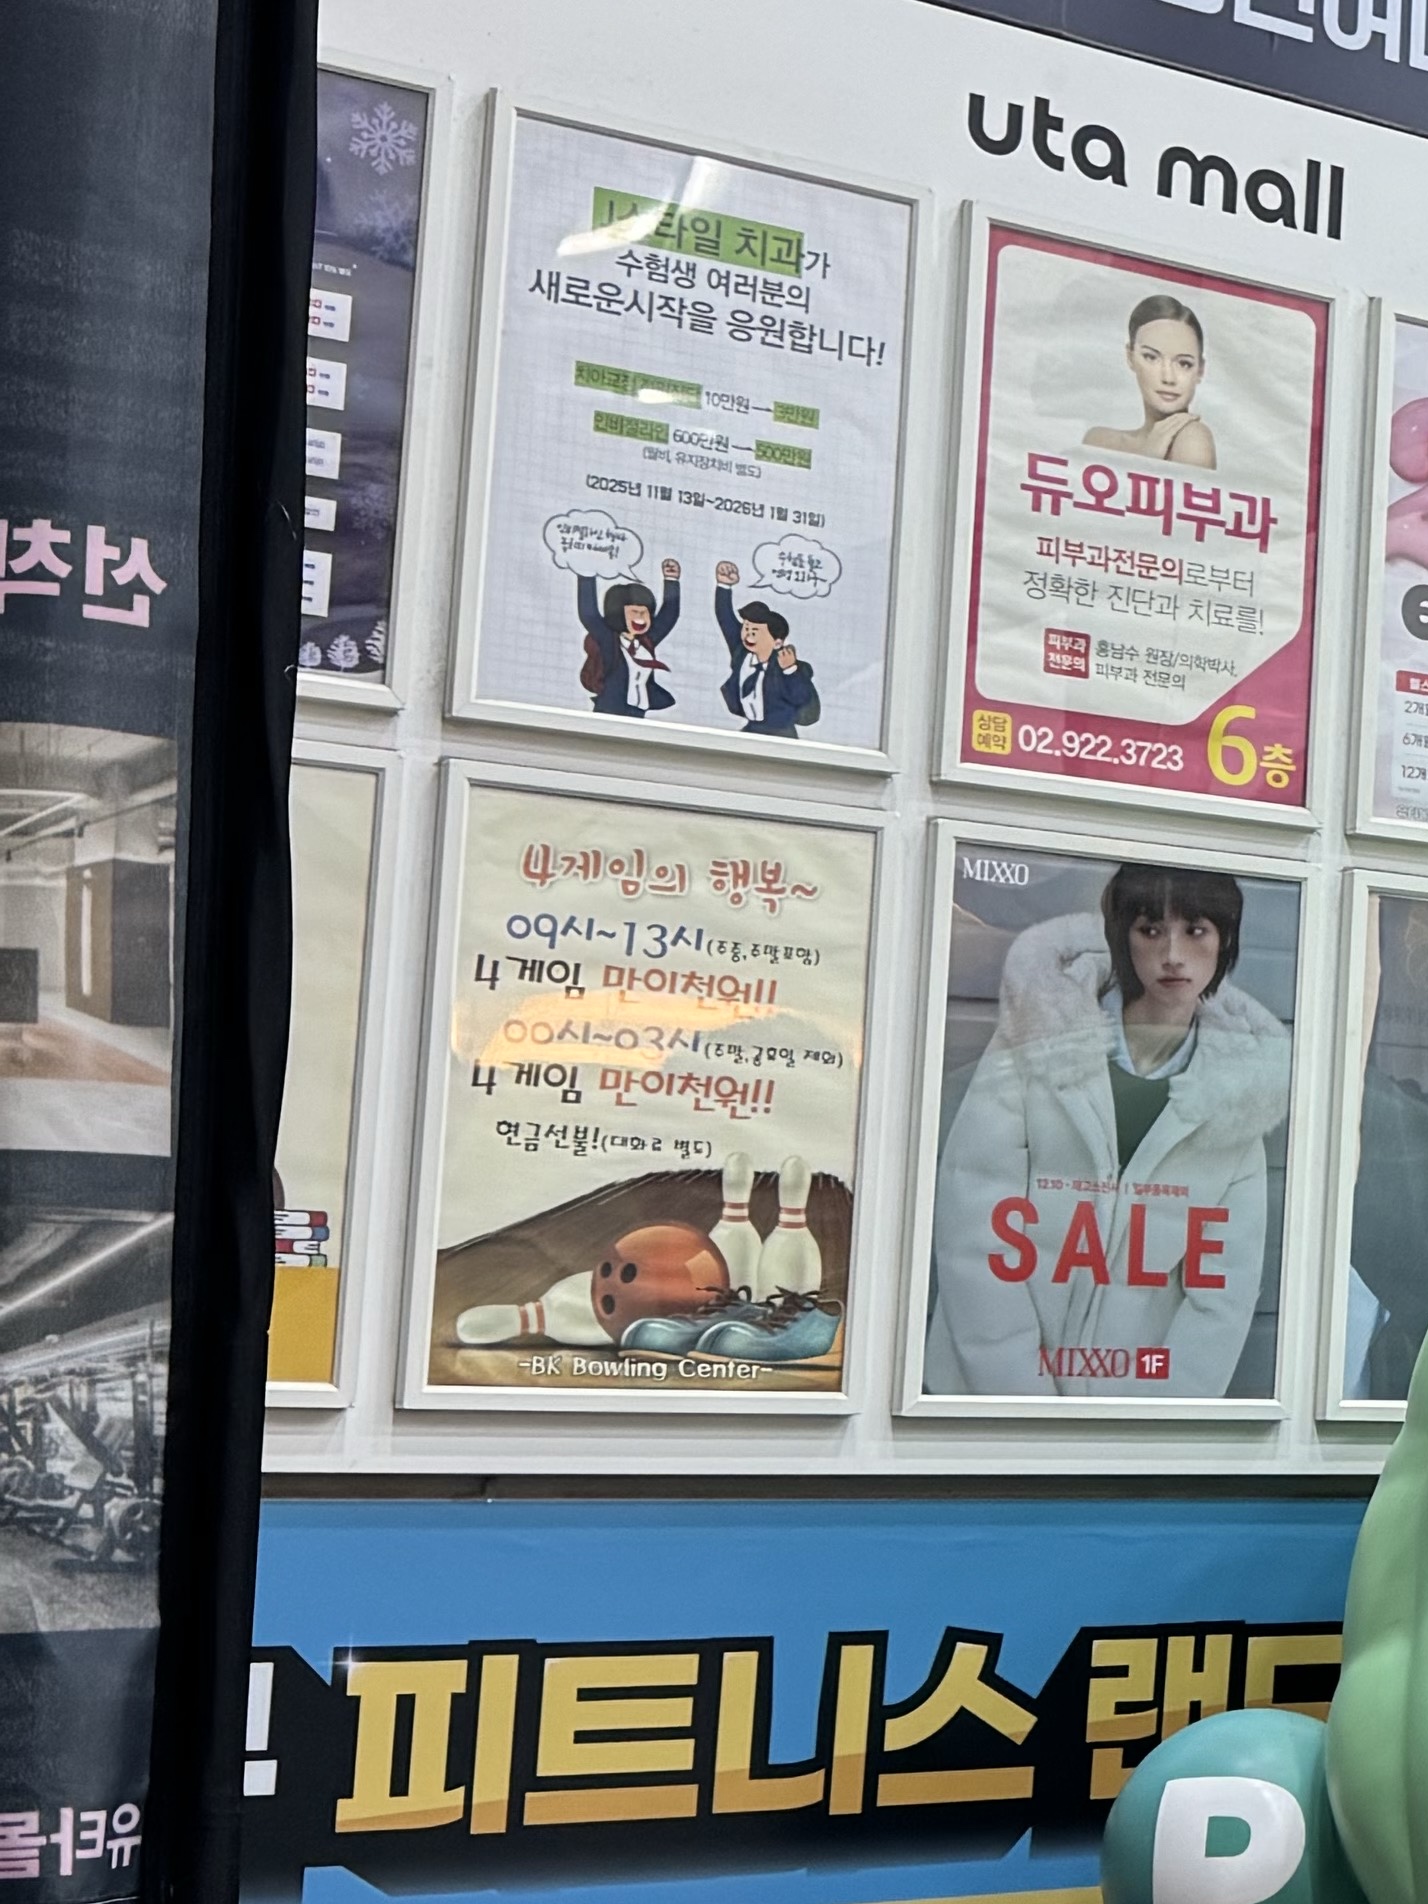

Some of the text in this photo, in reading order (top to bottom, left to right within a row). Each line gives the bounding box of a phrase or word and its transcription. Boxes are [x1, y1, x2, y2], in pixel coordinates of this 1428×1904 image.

[967, 92, 1344, 241] uta mall
[615, 248, 811, 314] 수험생 여러분의
[528, 268, 886, 368] 새로운시작을 응원합니다!
[1020, 452, 1279, 554] 듀오피부과
[1036, 536, 1254, 598] 피부과전문의로부터
[1023, 570, 1264, 637] 정확한 진단과 치료를!
[1047, 632, 1087, 654] 피부과
[1047, 651, 1087, 673] 전문의
[1095, 662, 1187, 692] 피부과 전문의
[976, 713, 1009, 733] 상담
[976, 732, 1009, 753] 예약
[1018, 723, 1185, 772] 02.922.3723
[962, 855, 1030, 886] MIXXO
[599, 1066, 776, 1120] 만이천원!!
[987, 1196, 1230, 1290] SALE
[572, 1356, 668, 1381] Bowling
[1038, 1347, 1166, 1379] MIXXO 1F
[335, 1641, 1038, 1834] 피트니스
